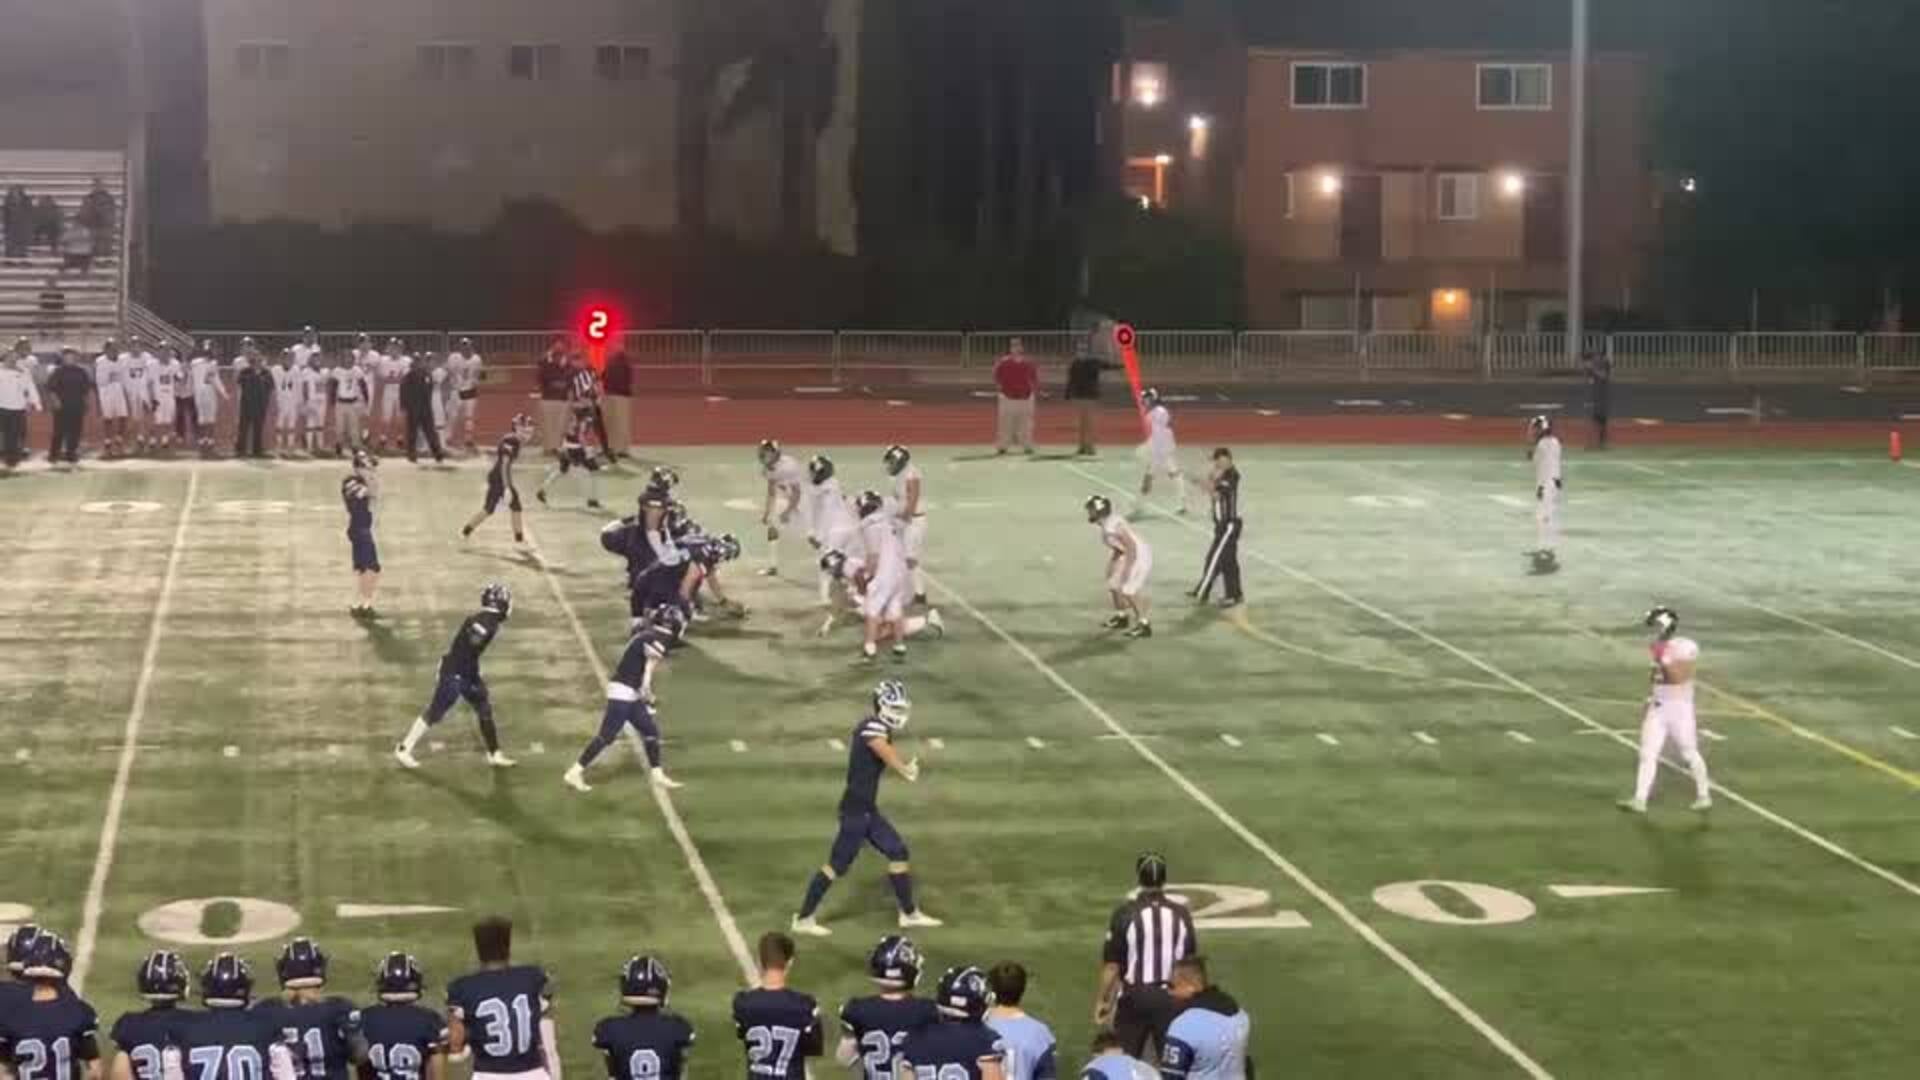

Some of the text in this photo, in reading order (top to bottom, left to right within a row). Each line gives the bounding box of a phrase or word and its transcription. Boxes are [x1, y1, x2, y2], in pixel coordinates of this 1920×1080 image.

[588, 310, 608, 339] 2
[474, 992, 532, 1057] 31
[15, 1035, 72, 1080] 21
[188, 1044, 263, 1080] 70
[745, 1025, 801, 1076] 27
